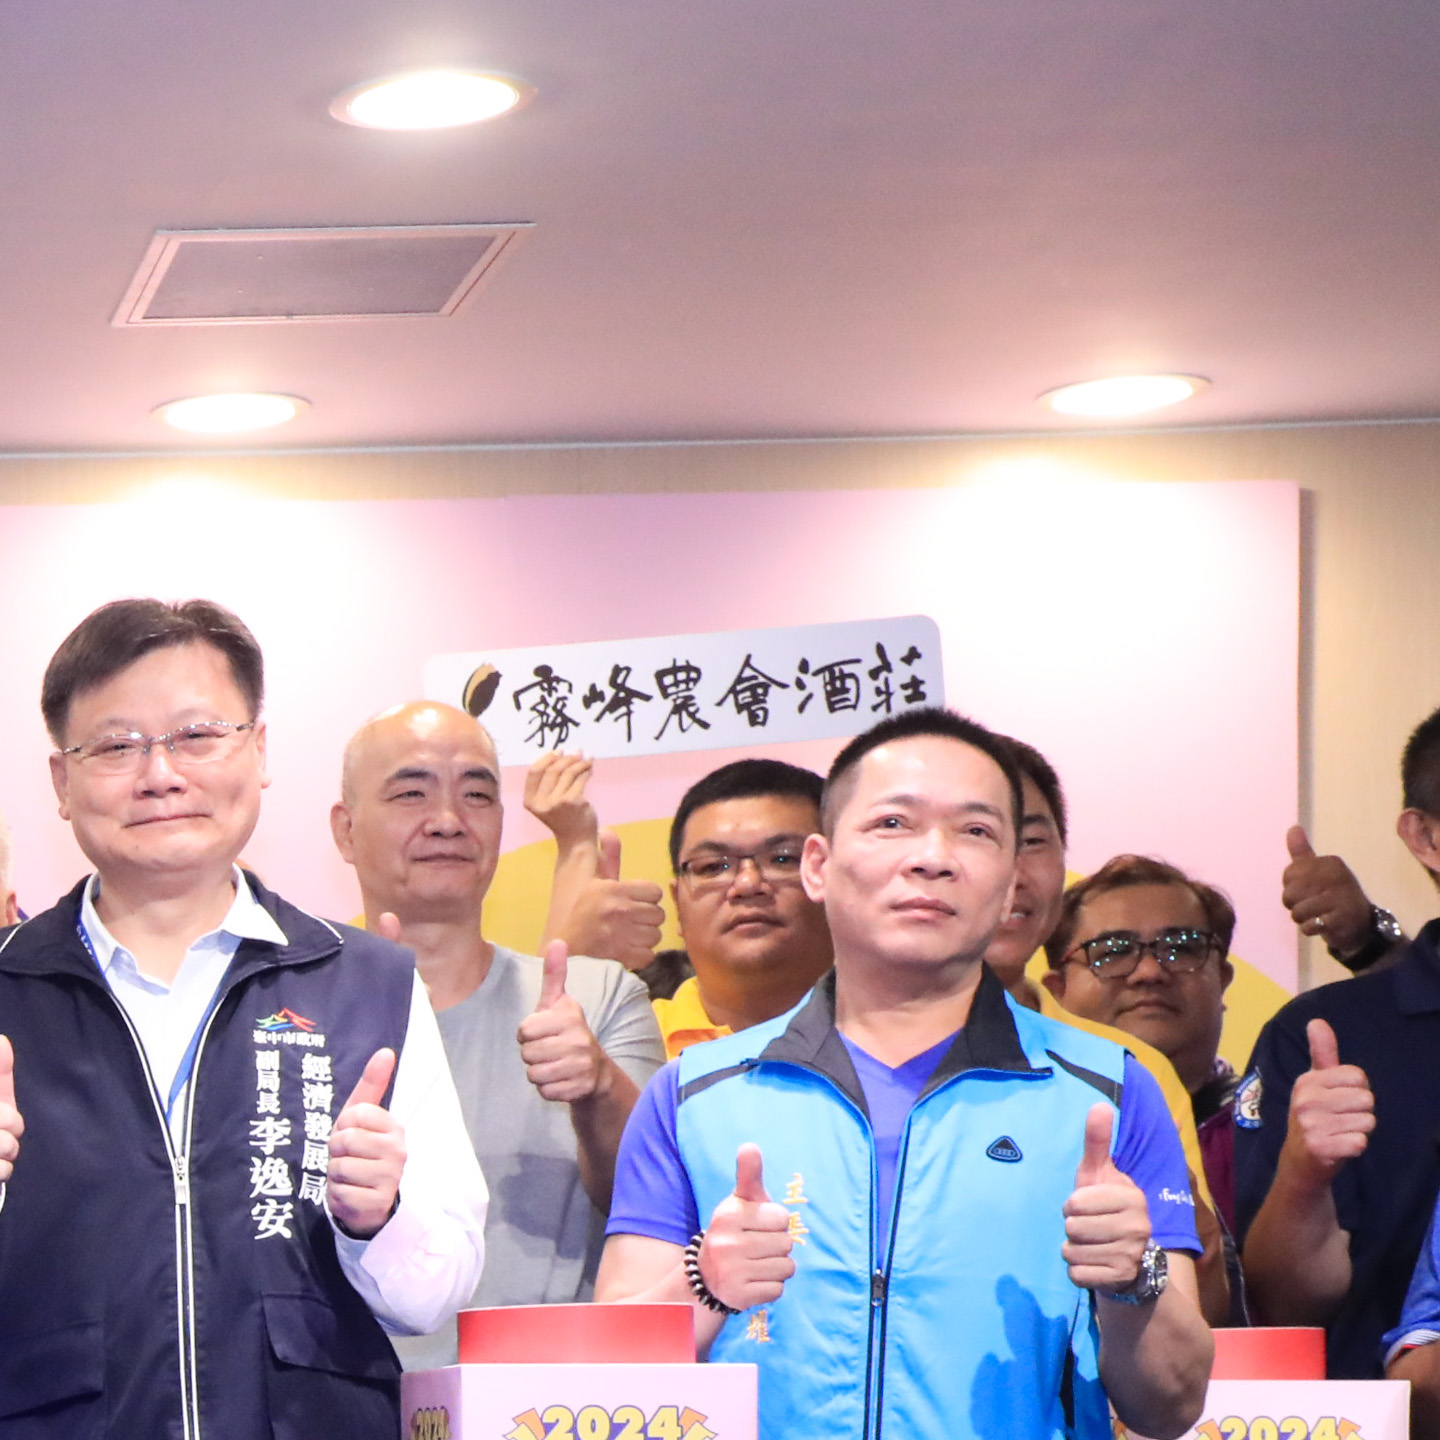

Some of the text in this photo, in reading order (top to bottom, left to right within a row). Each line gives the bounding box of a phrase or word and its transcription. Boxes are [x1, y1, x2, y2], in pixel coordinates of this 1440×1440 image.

[512, 642, 927, 750] 霧峰農會酒莊
[255, 1050, 281, 1115] 副局長
[300, 1052, 334, 1206] 經濟發展局
[249, 1116, 294, 1240] 李逸安
